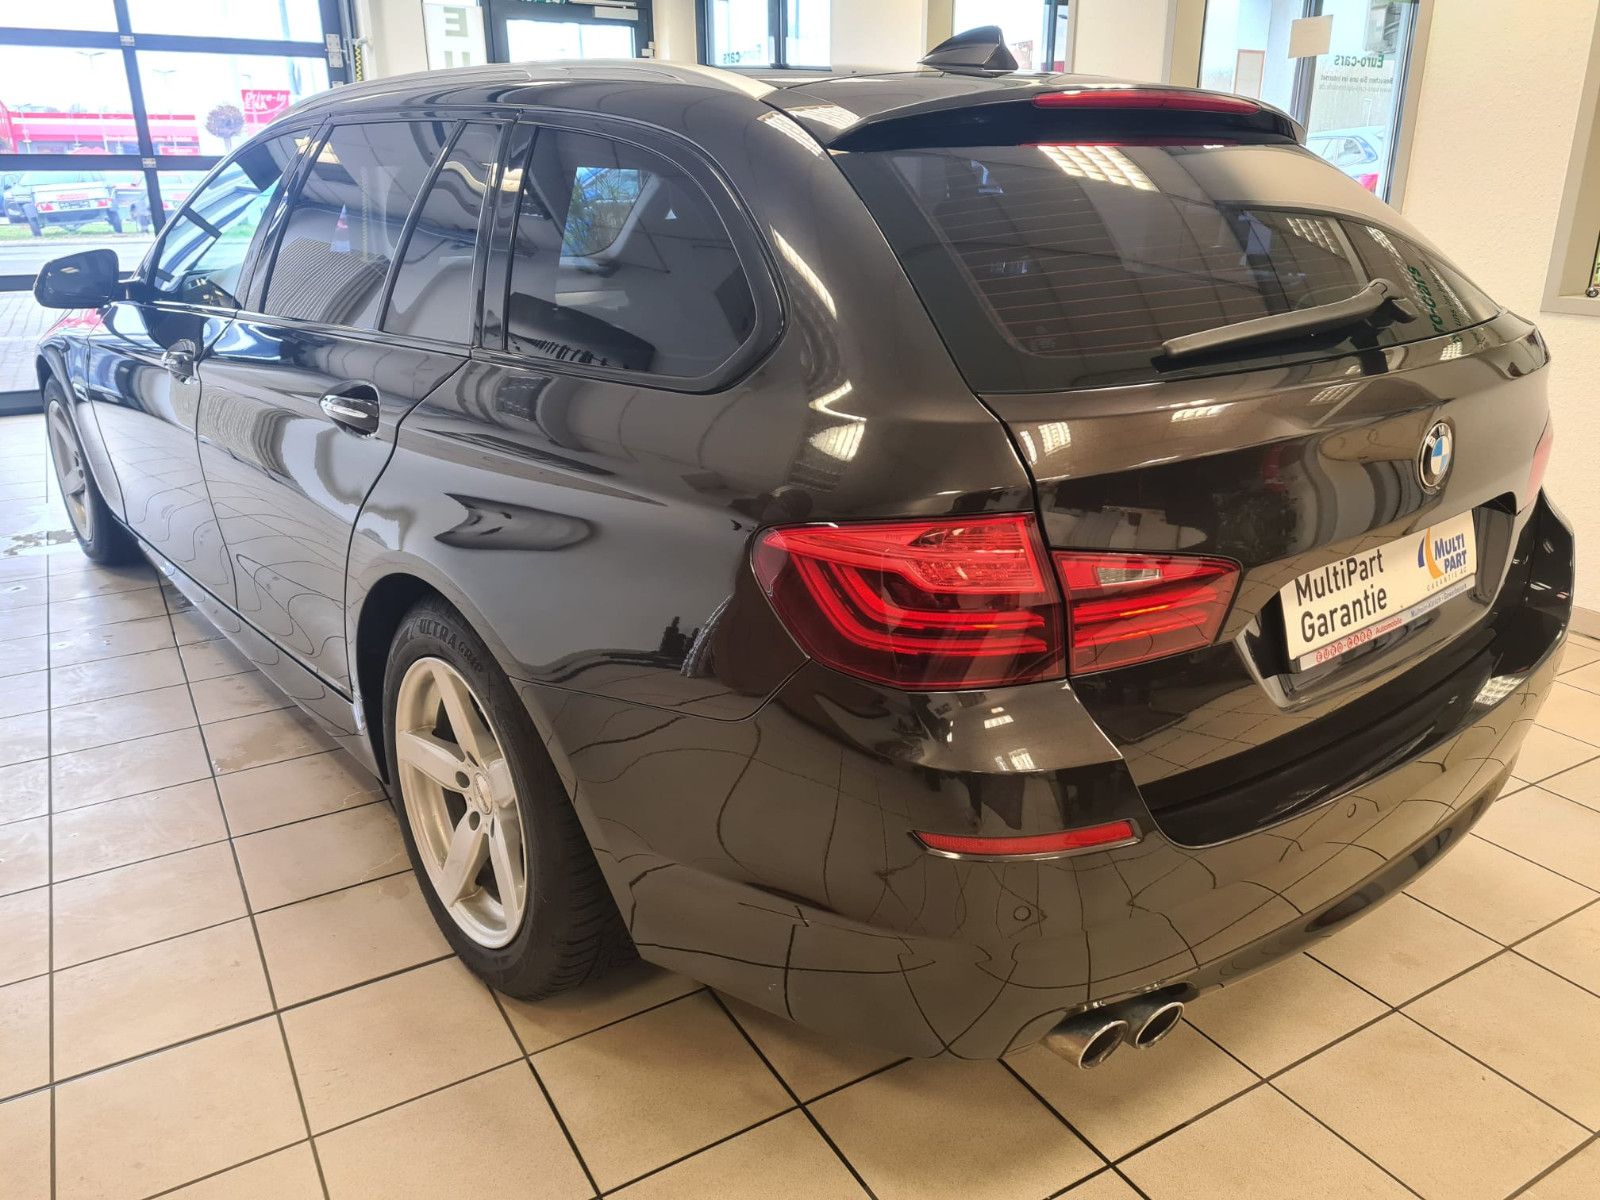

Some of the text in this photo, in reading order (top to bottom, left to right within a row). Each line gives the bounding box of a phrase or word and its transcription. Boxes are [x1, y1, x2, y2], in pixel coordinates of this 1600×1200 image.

[1434, 533, 1465, 561] MULTI
[1444, 550, 1467, 574] PART
[1294, 548, 1384, 606] MultiPart
[1301, 583, 1388, 643] Garantie
